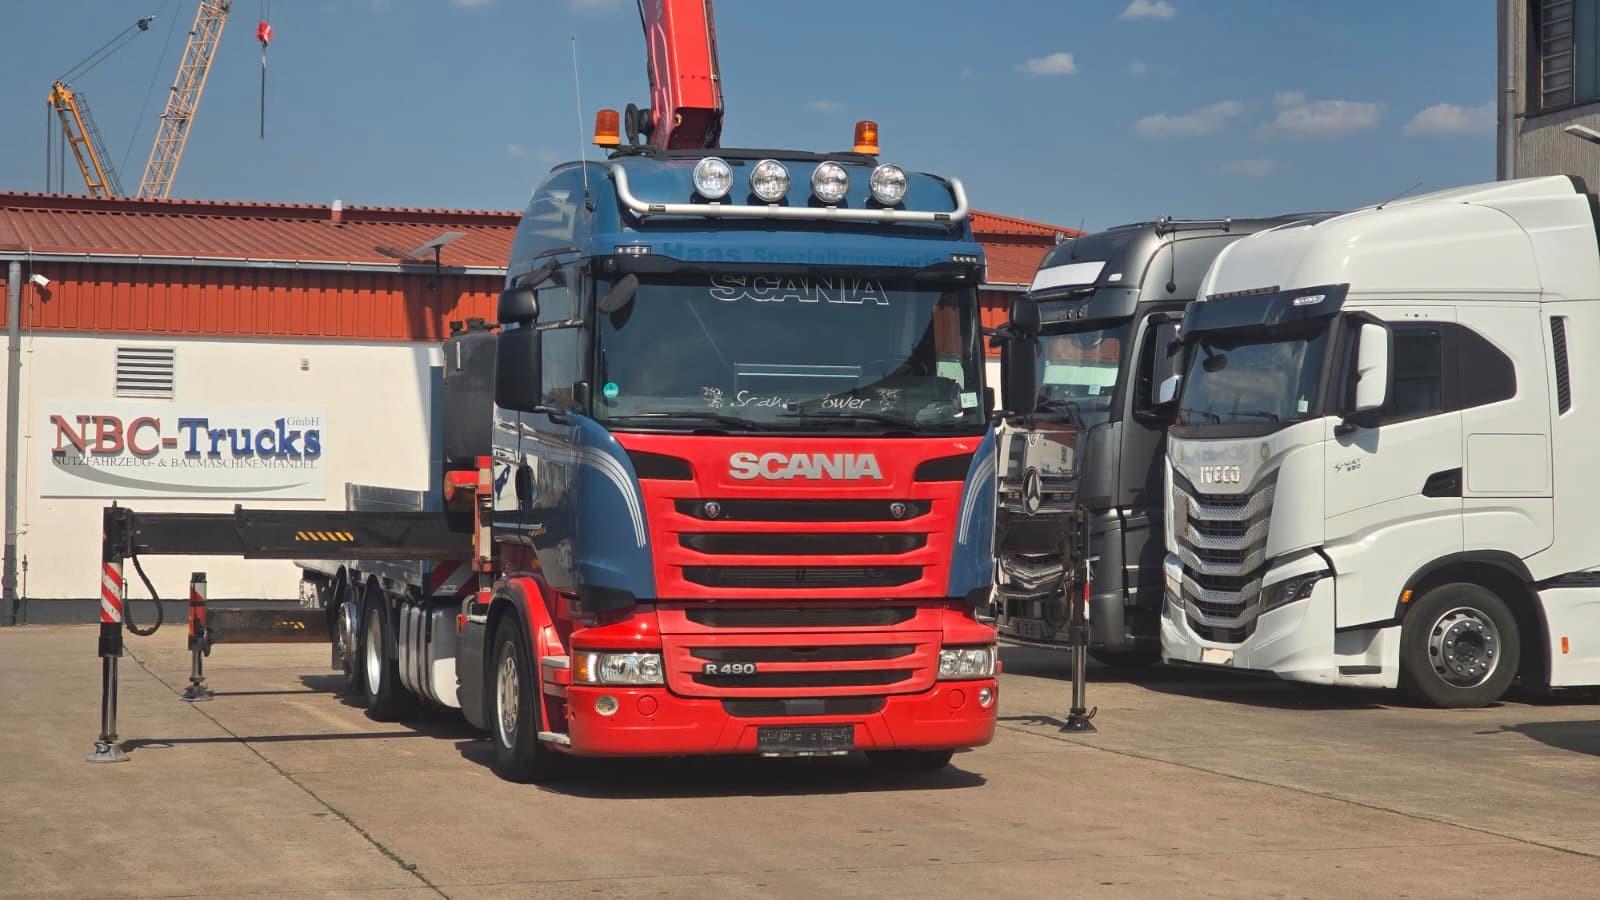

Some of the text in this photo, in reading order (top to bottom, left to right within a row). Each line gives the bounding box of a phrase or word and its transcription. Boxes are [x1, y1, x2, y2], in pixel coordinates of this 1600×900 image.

[710, 275, 890, 306] SCANIA
[50, 414, 321, 461] NBC-Trucks GmbH
[53, 455, 318, 470] NUTZFAHRZEUG- & BAUMASCHINENHANDEL
[728, 451, 884, 481] SCANIA
[1200, 464, 1241, 484] IVECO
[705, 663, 755, 674] R 490
